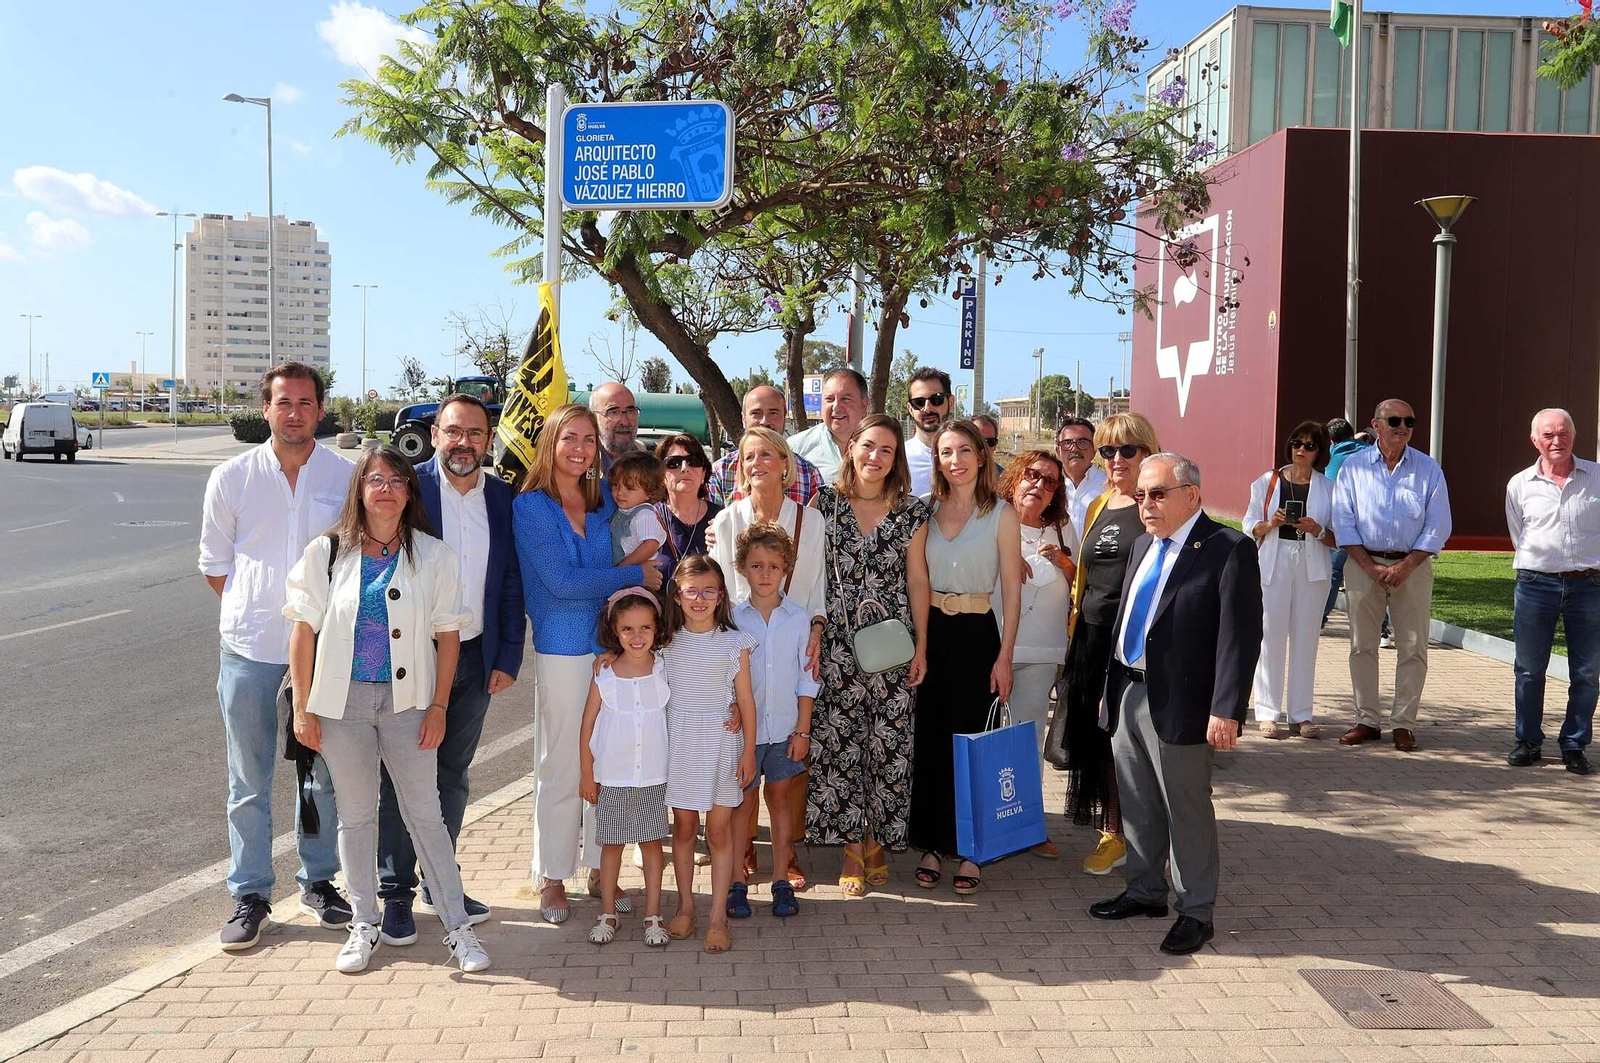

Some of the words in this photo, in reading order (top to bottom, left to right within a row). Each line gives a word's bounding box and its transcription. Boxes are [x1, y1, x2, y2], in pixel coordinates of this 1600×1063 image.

[576, 134, 615, 142] GLORIETA
[575, 144, 656, 161] ARQUITECTO
[575, 162, 608, 181] JOSÉ
[612, 163, 655, 180] PABLO
[574, 180, 632, 200] VÁZQUEZ
[636, 182, 686, 199] HIERRO
[960, 279, 973, 294] P
[963, 300, 974, 366] PARKING
[1222, 330, 1228, 351] LA
[1215, 314, 1223, 375] CENTRO
[1227, 334, 1236, 375] Jesús
[1221, 355, 1227, 375] DE
[997, 806, 1023, 820] HUELVA
